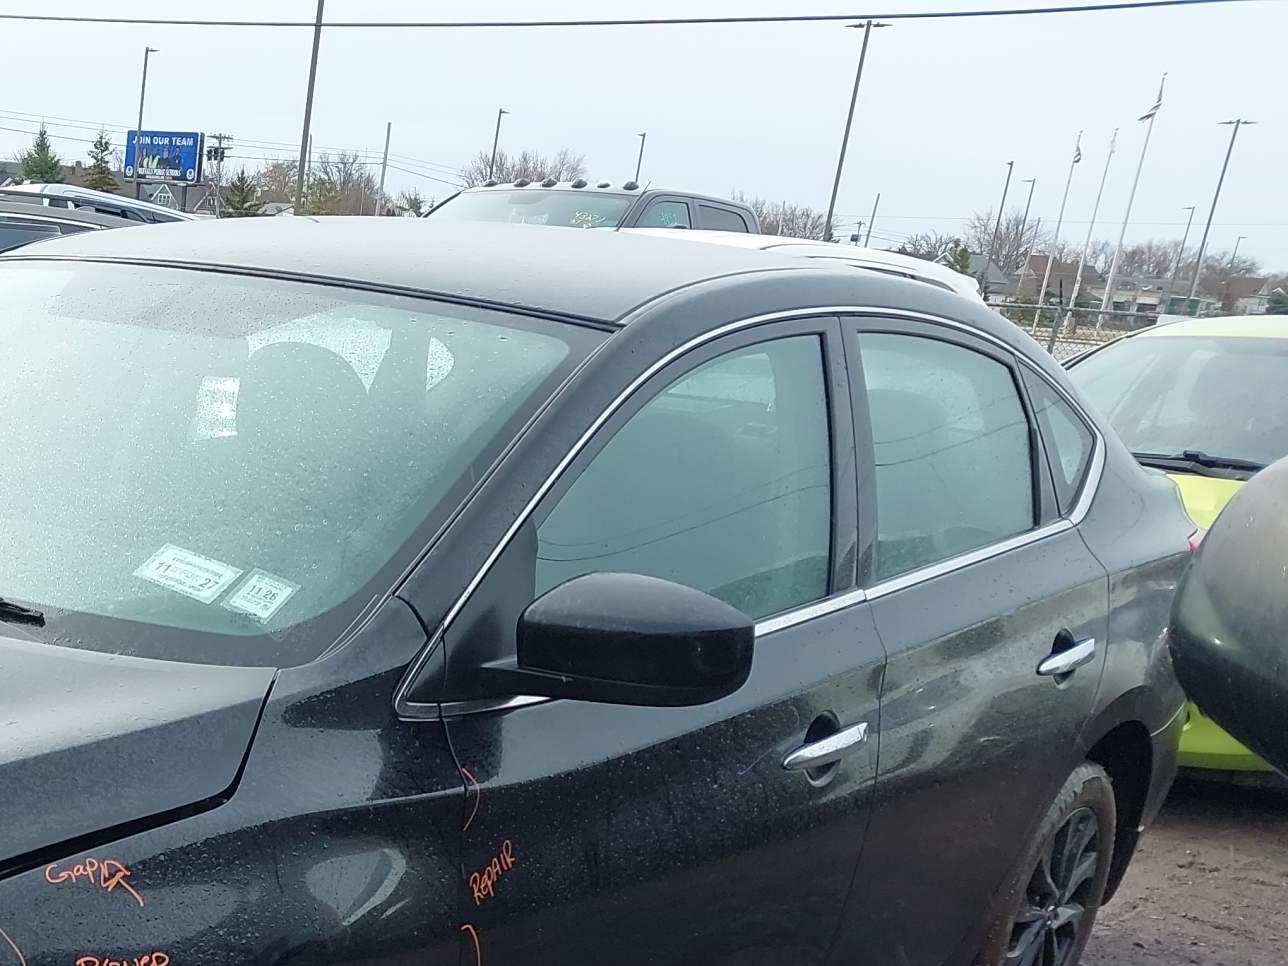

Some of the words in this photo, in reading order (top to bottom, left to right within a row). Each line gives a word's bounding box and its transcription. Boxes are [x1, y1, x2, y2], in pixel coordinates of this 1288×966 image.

[132, 135, 151, 145] JOIN
[152, 136, 170, 145] OUR
[171, 137, 194, 146] TEAM
